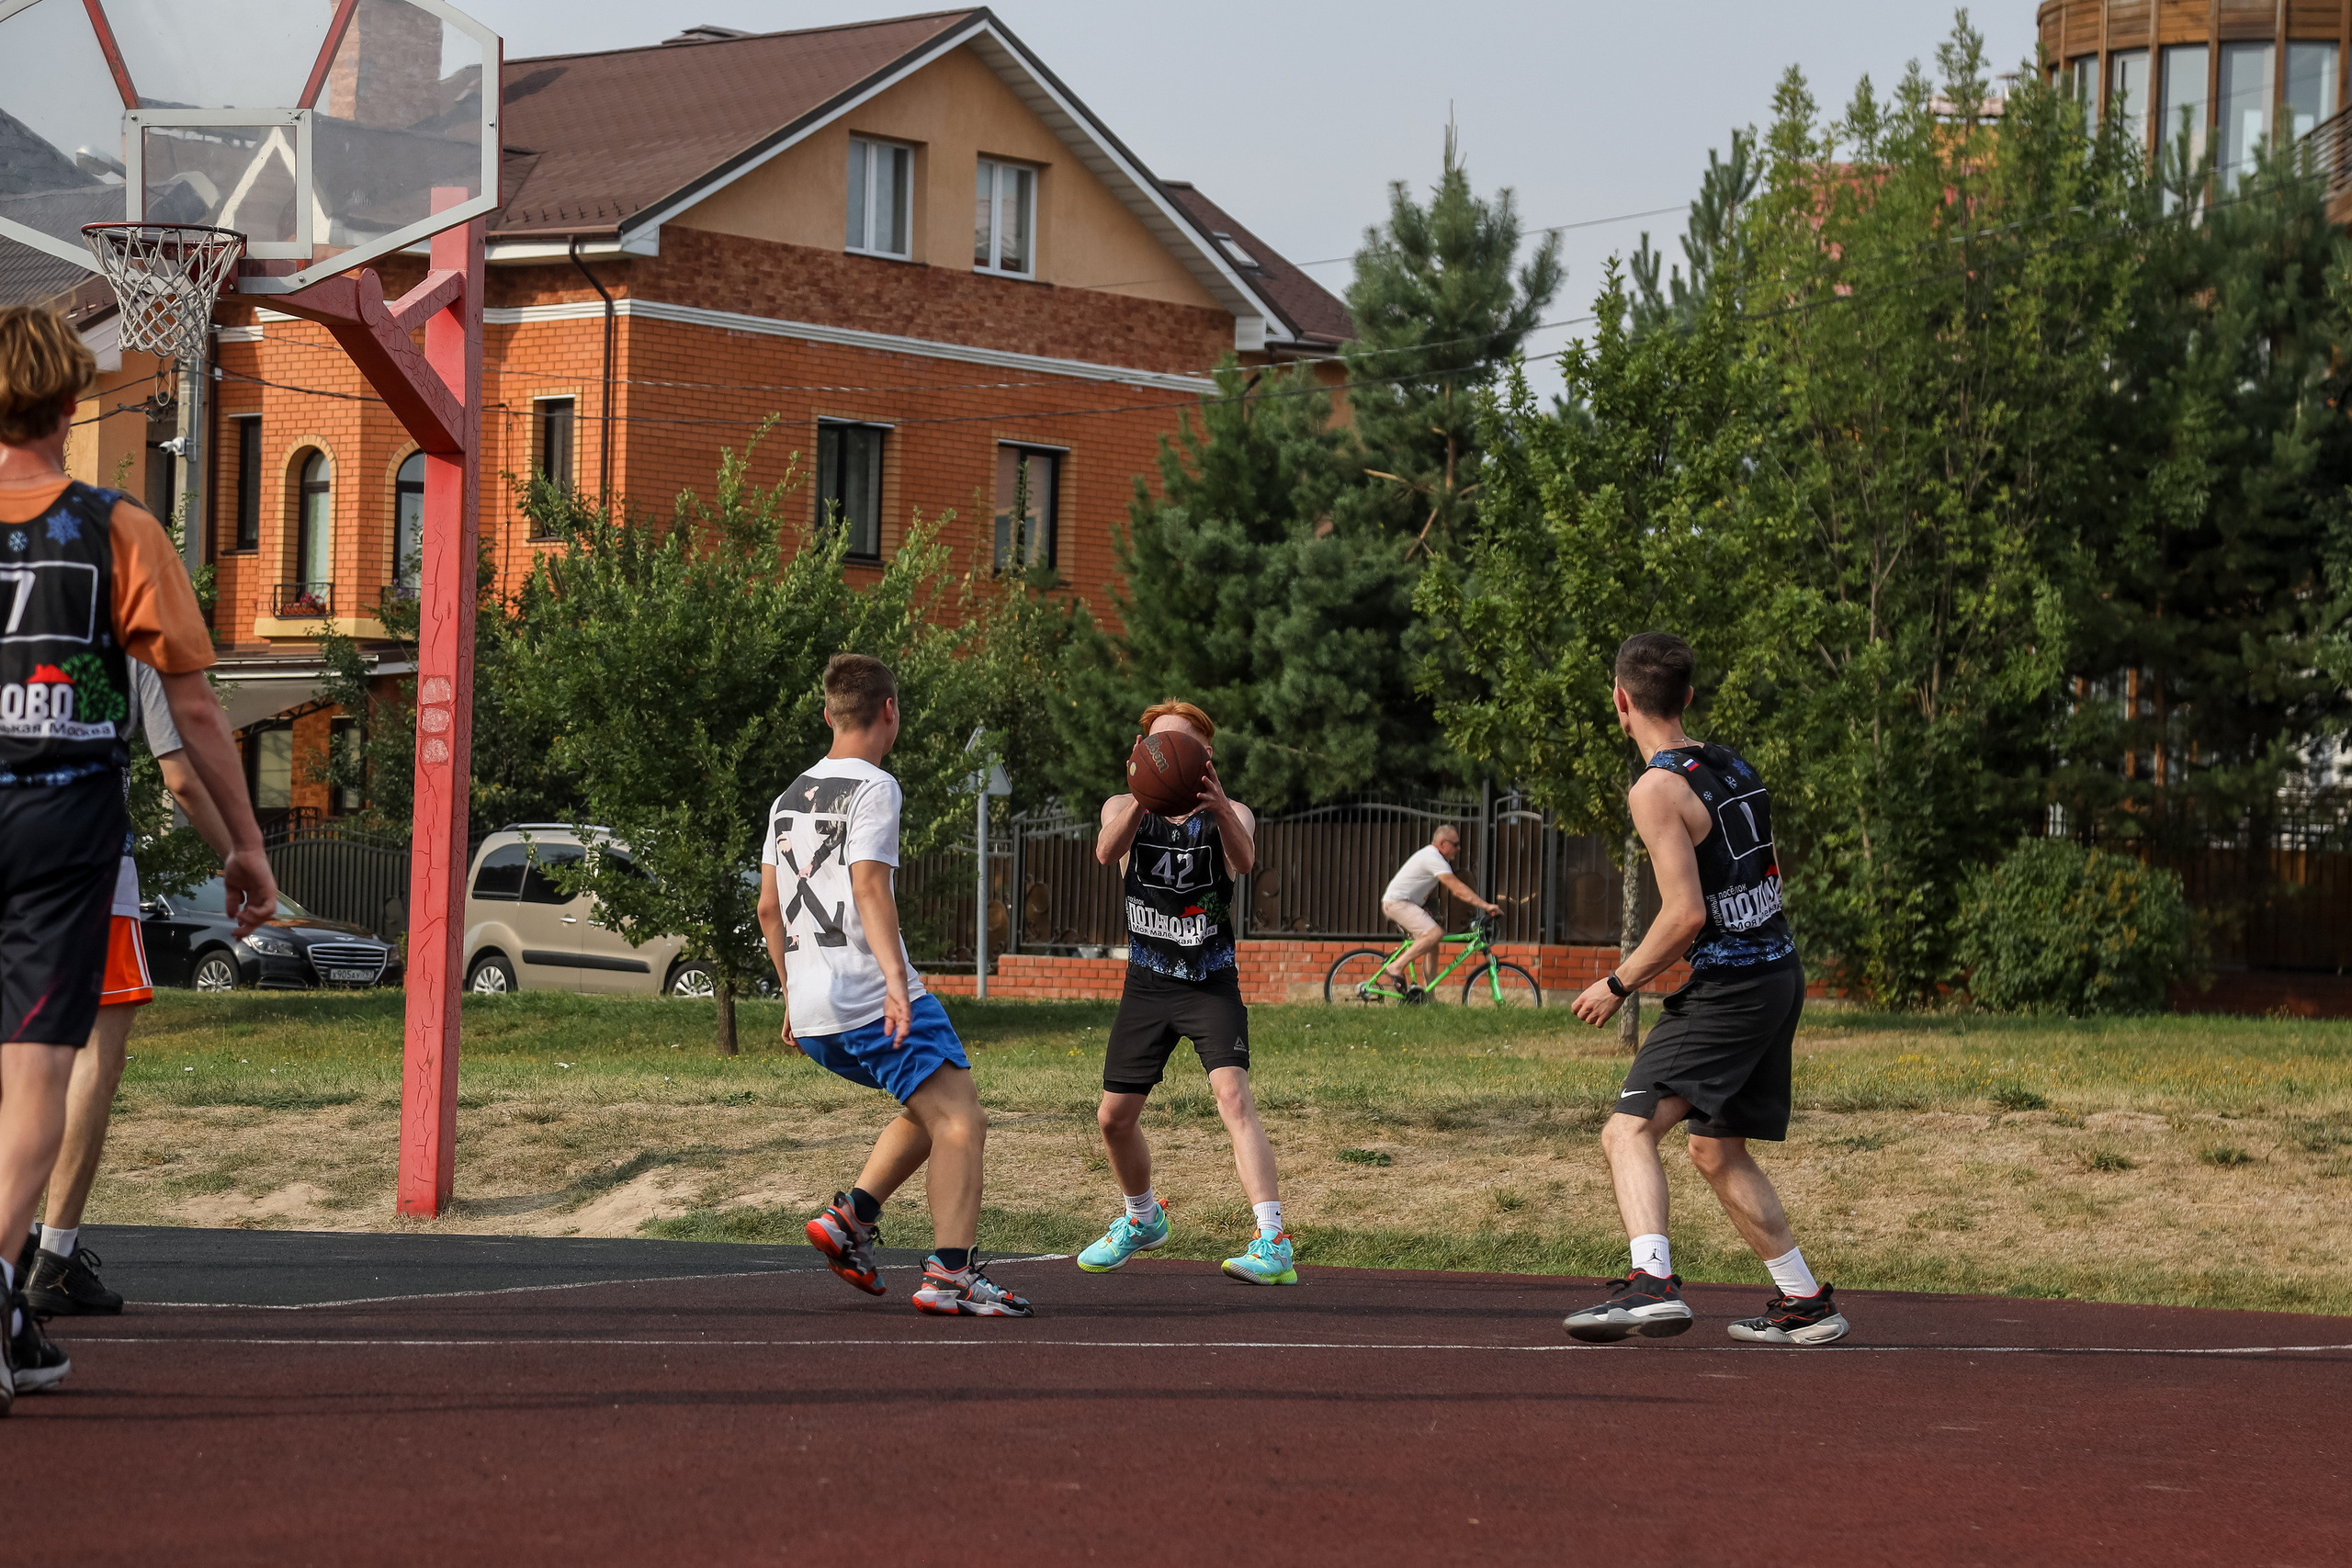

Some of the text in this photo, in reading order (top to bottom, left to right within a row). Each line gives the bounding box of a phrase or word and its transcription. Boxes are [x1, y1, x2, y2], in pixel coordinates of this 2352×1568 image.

[0, 682, 74, 721] ОВО
[1143, 733, 1170, 773] ilson
[1150, 852, 1194, 888] 42
[1132, 925, 1149, 935] Моя
[1149, 930, 1193, 945] малекая
